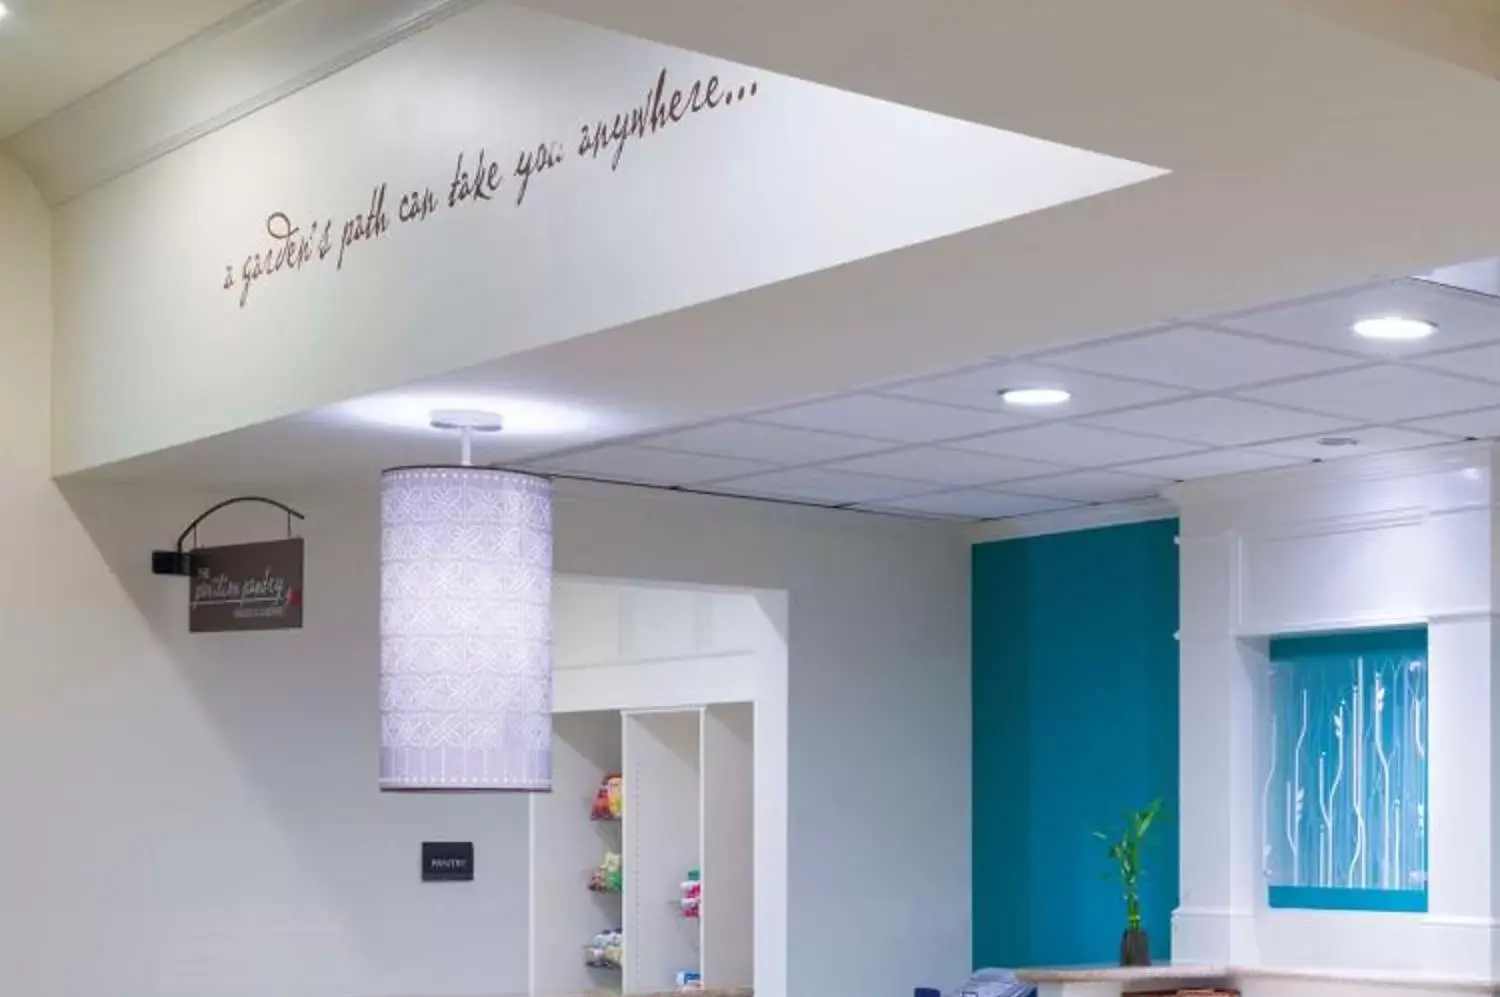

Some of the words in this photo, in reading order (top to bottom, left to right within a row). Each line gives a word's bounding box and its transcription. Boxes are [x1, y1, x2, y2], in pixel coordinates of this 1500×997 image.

[223, 265, 234, 289] a
[239, 211, 332, 308] garden's
[337, 183, 391, 271] path
[399, 186, 438, 222] can
[448, 147, 503, 208] take
[513, 142, 564, 209] you
[578, 66, 758, 171] anywhere...
